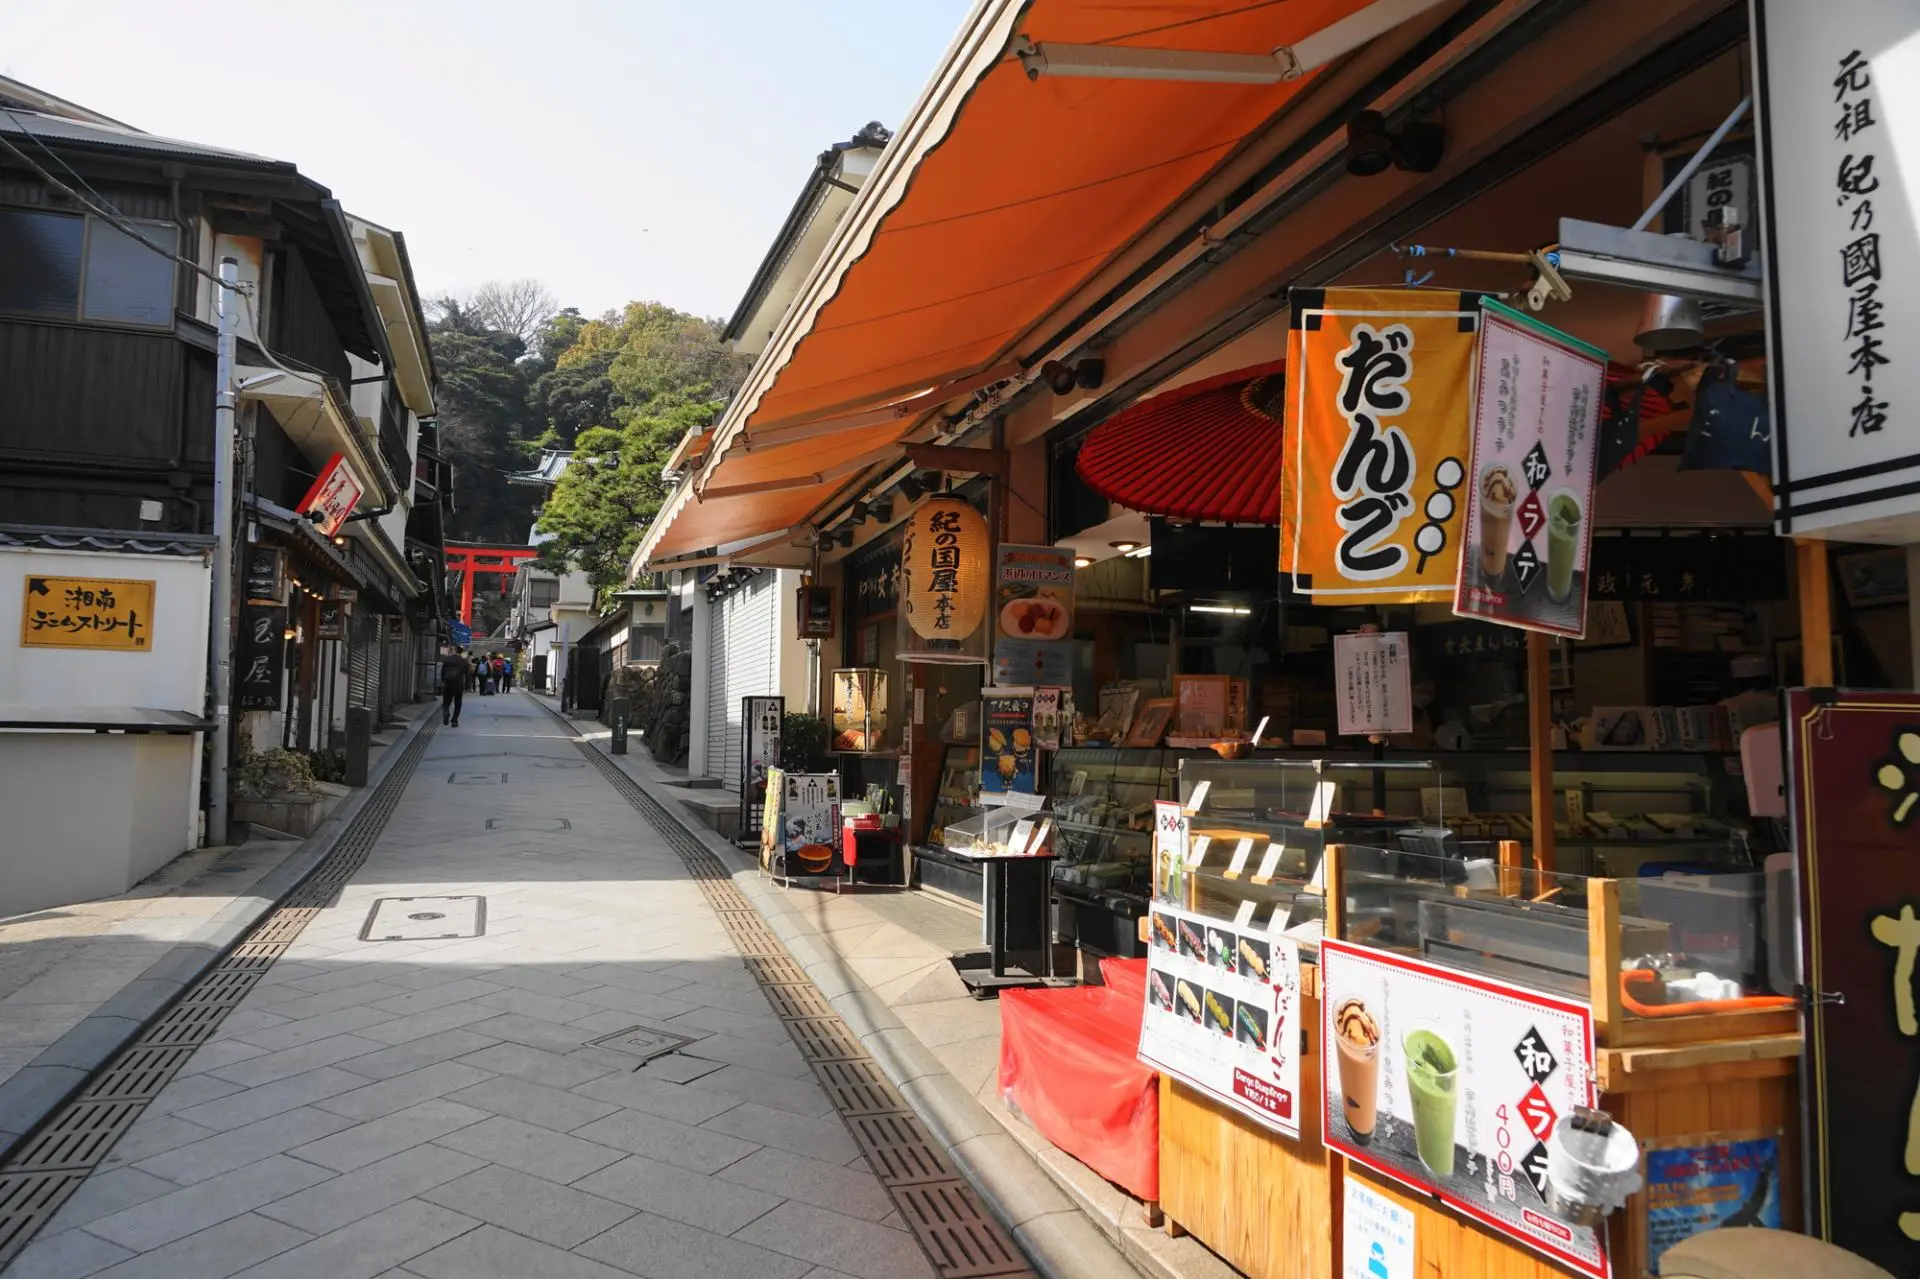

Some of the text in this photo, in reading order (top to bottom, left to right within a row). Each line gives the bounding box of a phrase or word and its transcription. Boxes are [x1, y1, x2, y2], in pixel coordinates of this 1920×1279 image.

[1333, 325, 1413, 578] だんご
[928, 510, 961, 630] 紀の国屋本店
[1517, 451, 1547, 581] 和ラテ
[30, 609, 143, 638] デニムストリート
[65, 586, 116, 612] 湘南
